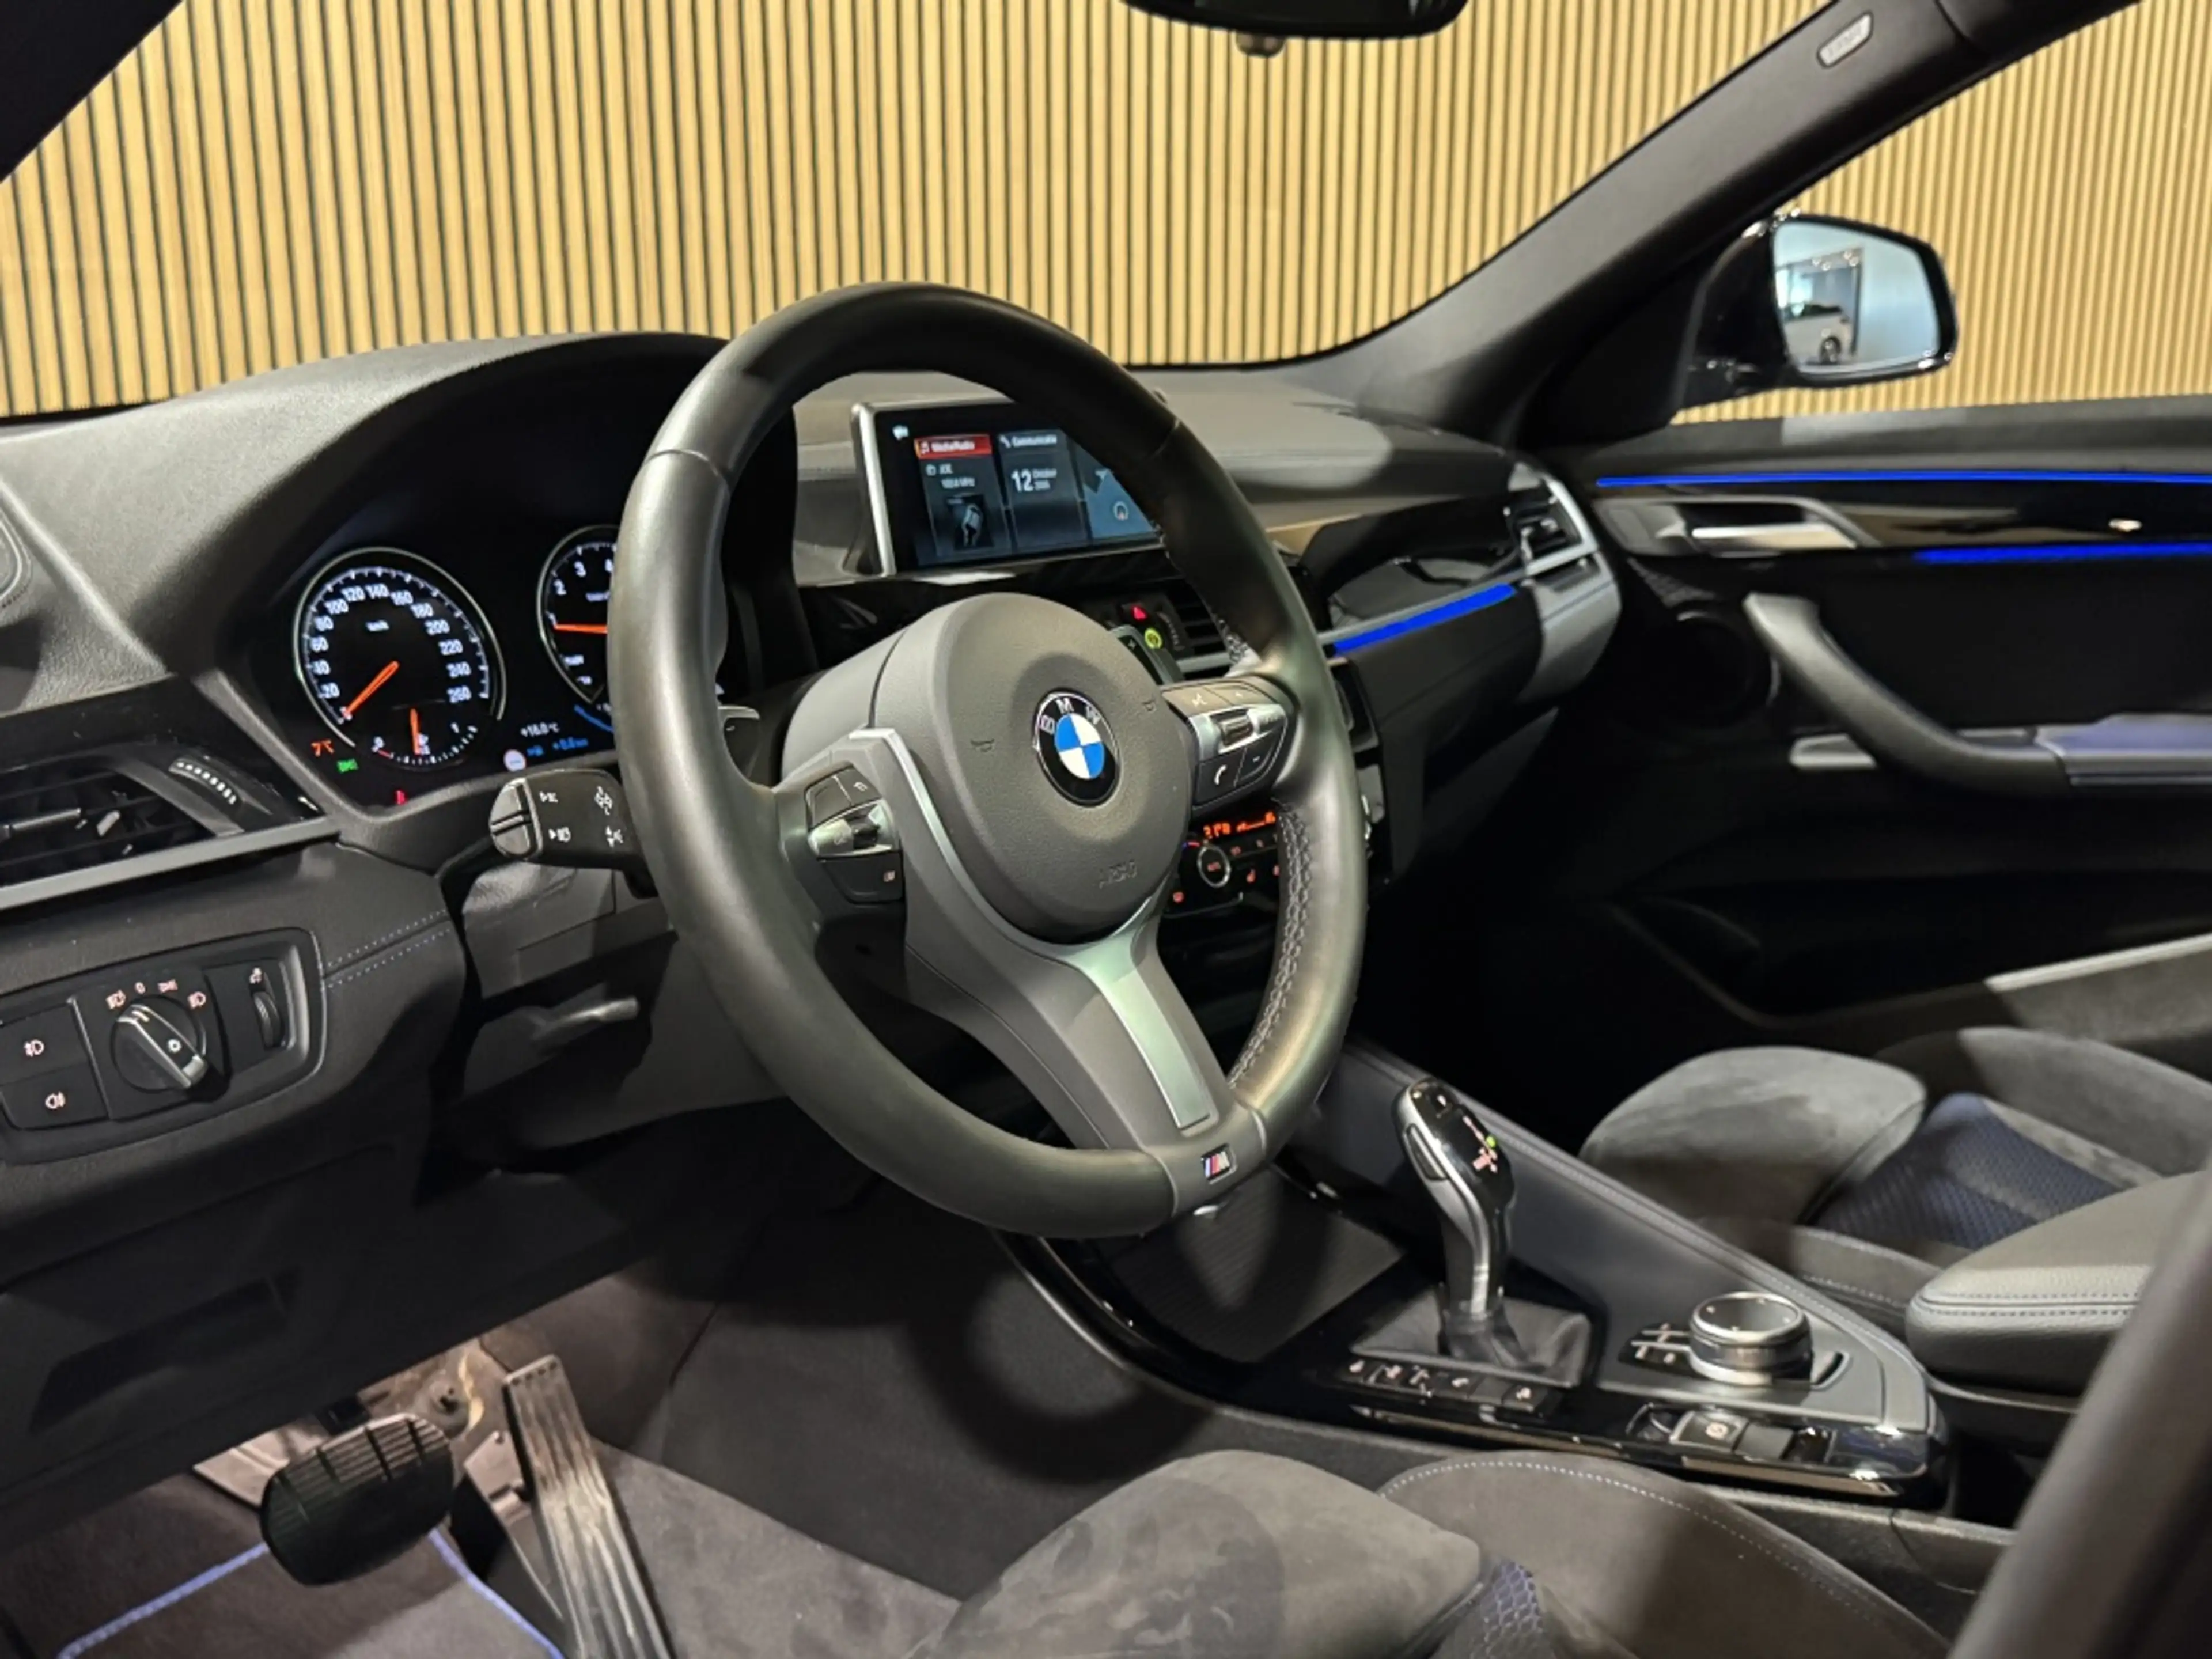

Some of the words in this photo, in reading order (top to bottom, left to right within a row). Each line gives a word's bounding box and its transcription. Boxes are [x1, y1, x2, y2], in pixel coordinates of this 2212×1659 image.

[1011, 468, 1033, 493] 12
[574, 561, 586, 578] 3
[341, 585, 366, 602] 120
[554, 579, 567, 596] 2
[324, 598, 349, 615] 100
[425, 618, 450, 636] 200
[438, 638, 463, 656] 220
[318, 681, 340, 699] 20
[1040, 697, 1101, 735] BMW
